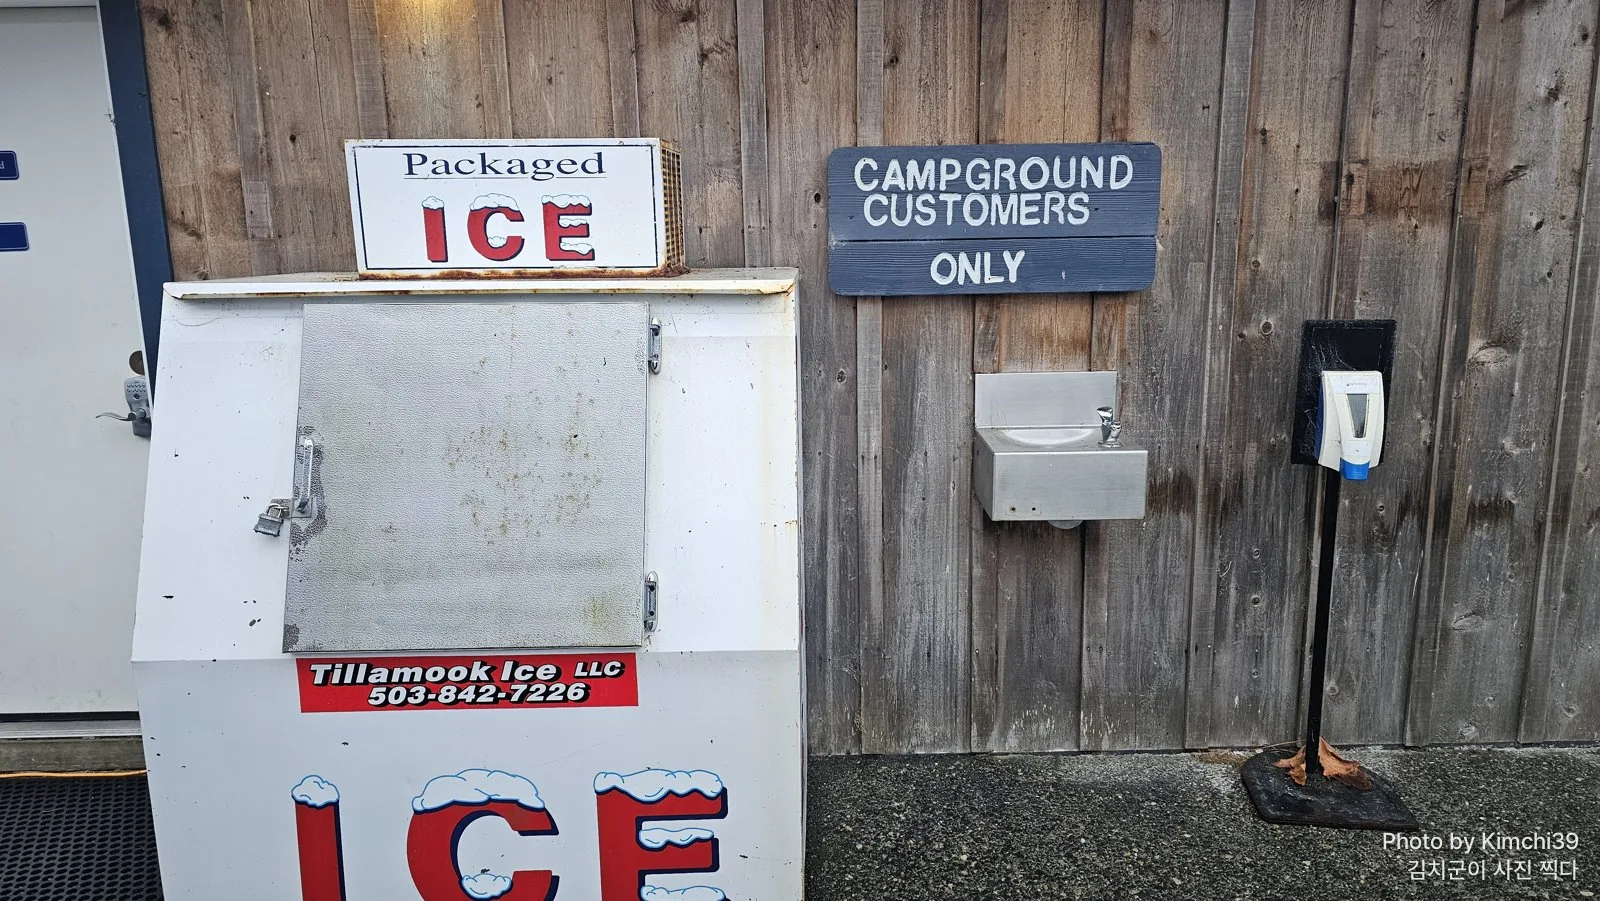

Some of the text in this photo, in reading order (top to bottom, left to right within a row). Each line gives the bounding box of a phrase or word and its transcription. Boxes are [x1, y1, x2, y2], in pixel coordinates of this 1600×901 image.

[403, 151, 607, 181] Packaged
[853, 154, 1134, 192] CAMPGROUND
[863, 191, 1090, 227] CUSTOMERS
[421, 193, 595, 262] ICE
[930, 250, 1025, 285] ONLY
[309, 660, 625, 685] Tillamook Ice LLC
[367, 682, 592, 707] 503-842-7226
[291, 769, 728, 901] ICE
